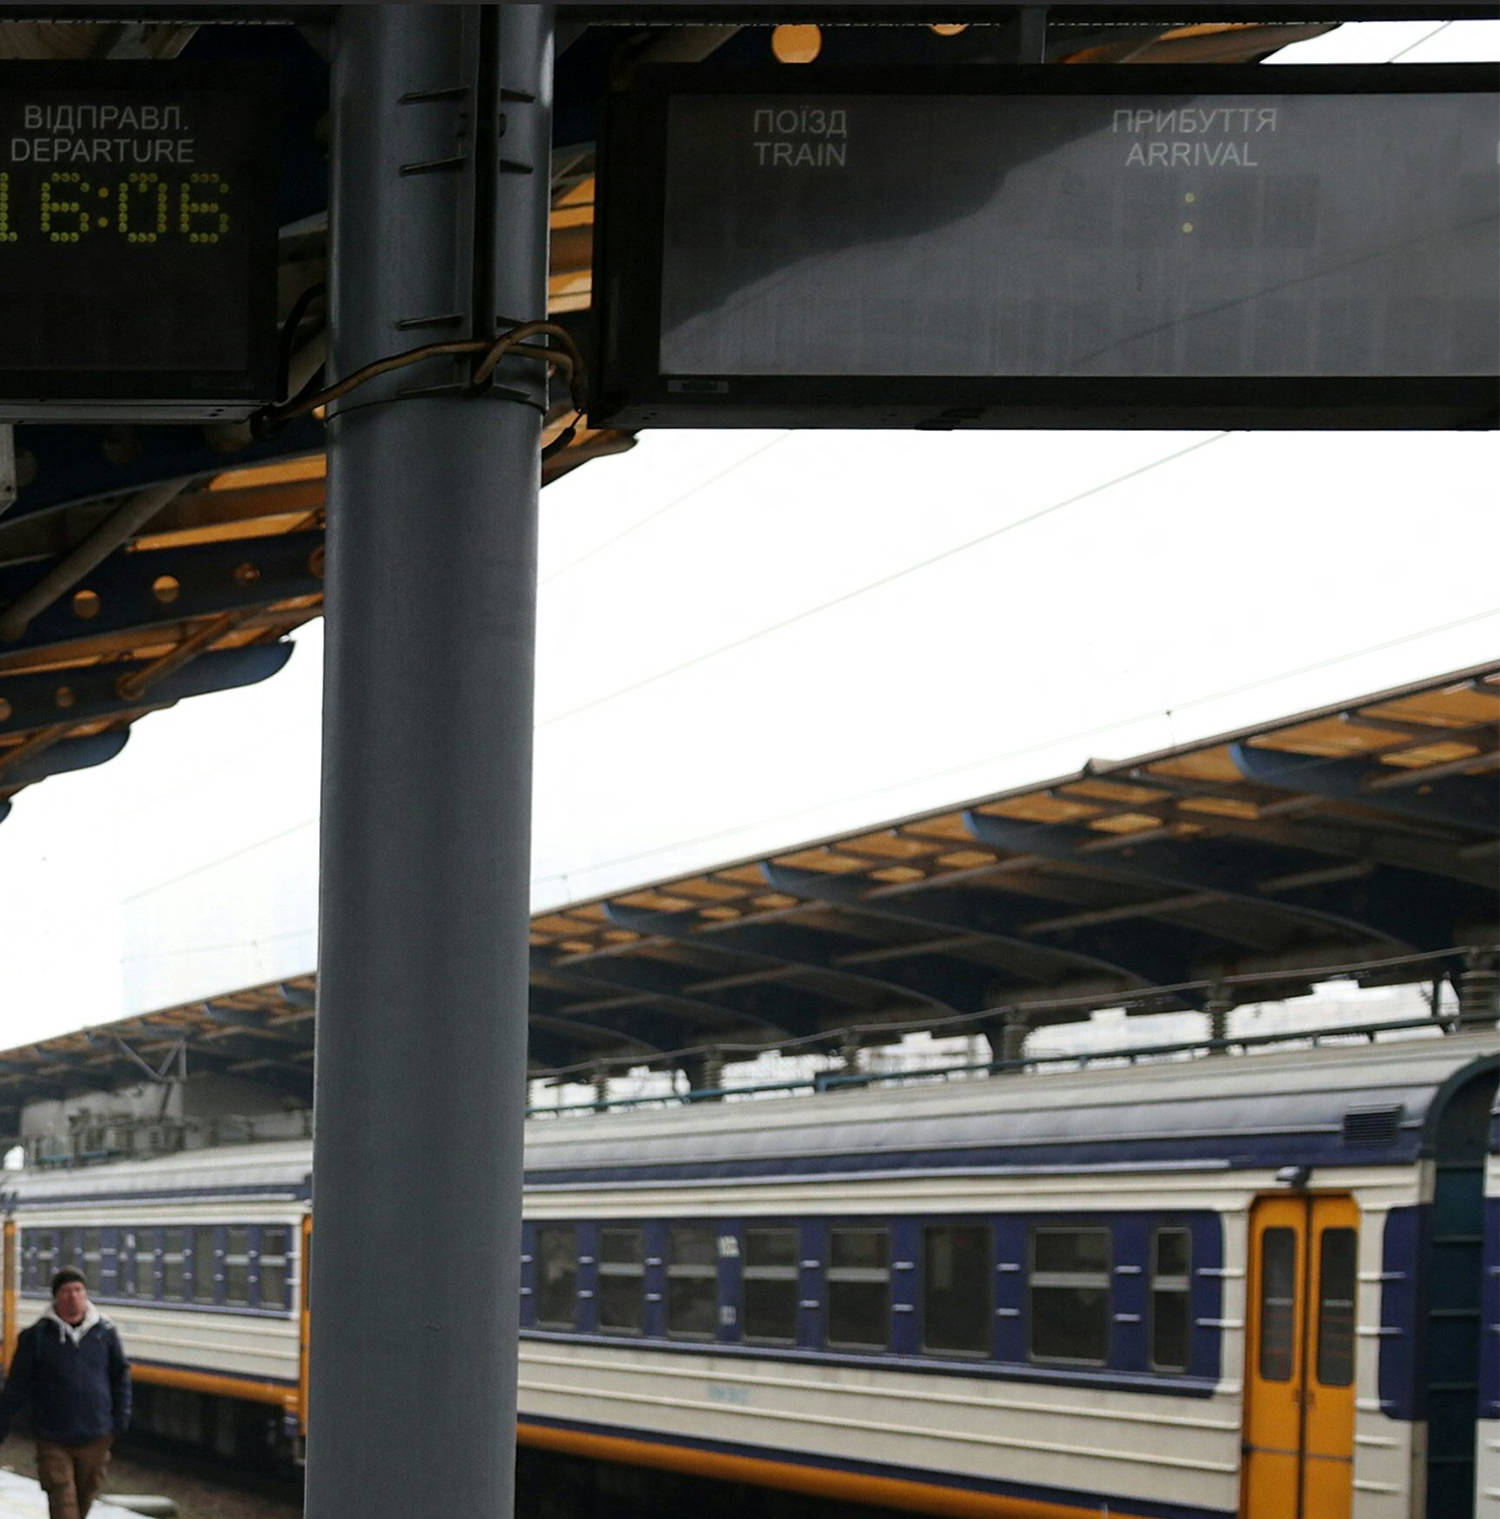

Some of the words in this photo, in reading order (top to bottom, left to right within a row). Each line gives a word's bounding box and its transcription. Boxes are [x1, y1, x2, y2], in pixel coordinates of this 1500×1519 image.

[24, 105, 189, 134] ВІДПРАВЛ.
[753, 105, 848, 138] ПОЇЗД
[1112, 107, 1277, 134] ПРИБУТТЯ
[11, 137, 194, 163] DEPARTURE
[753, 141, 847, 167] TRAIN
[1125, 141, 1258, 167] ARRIVAL
